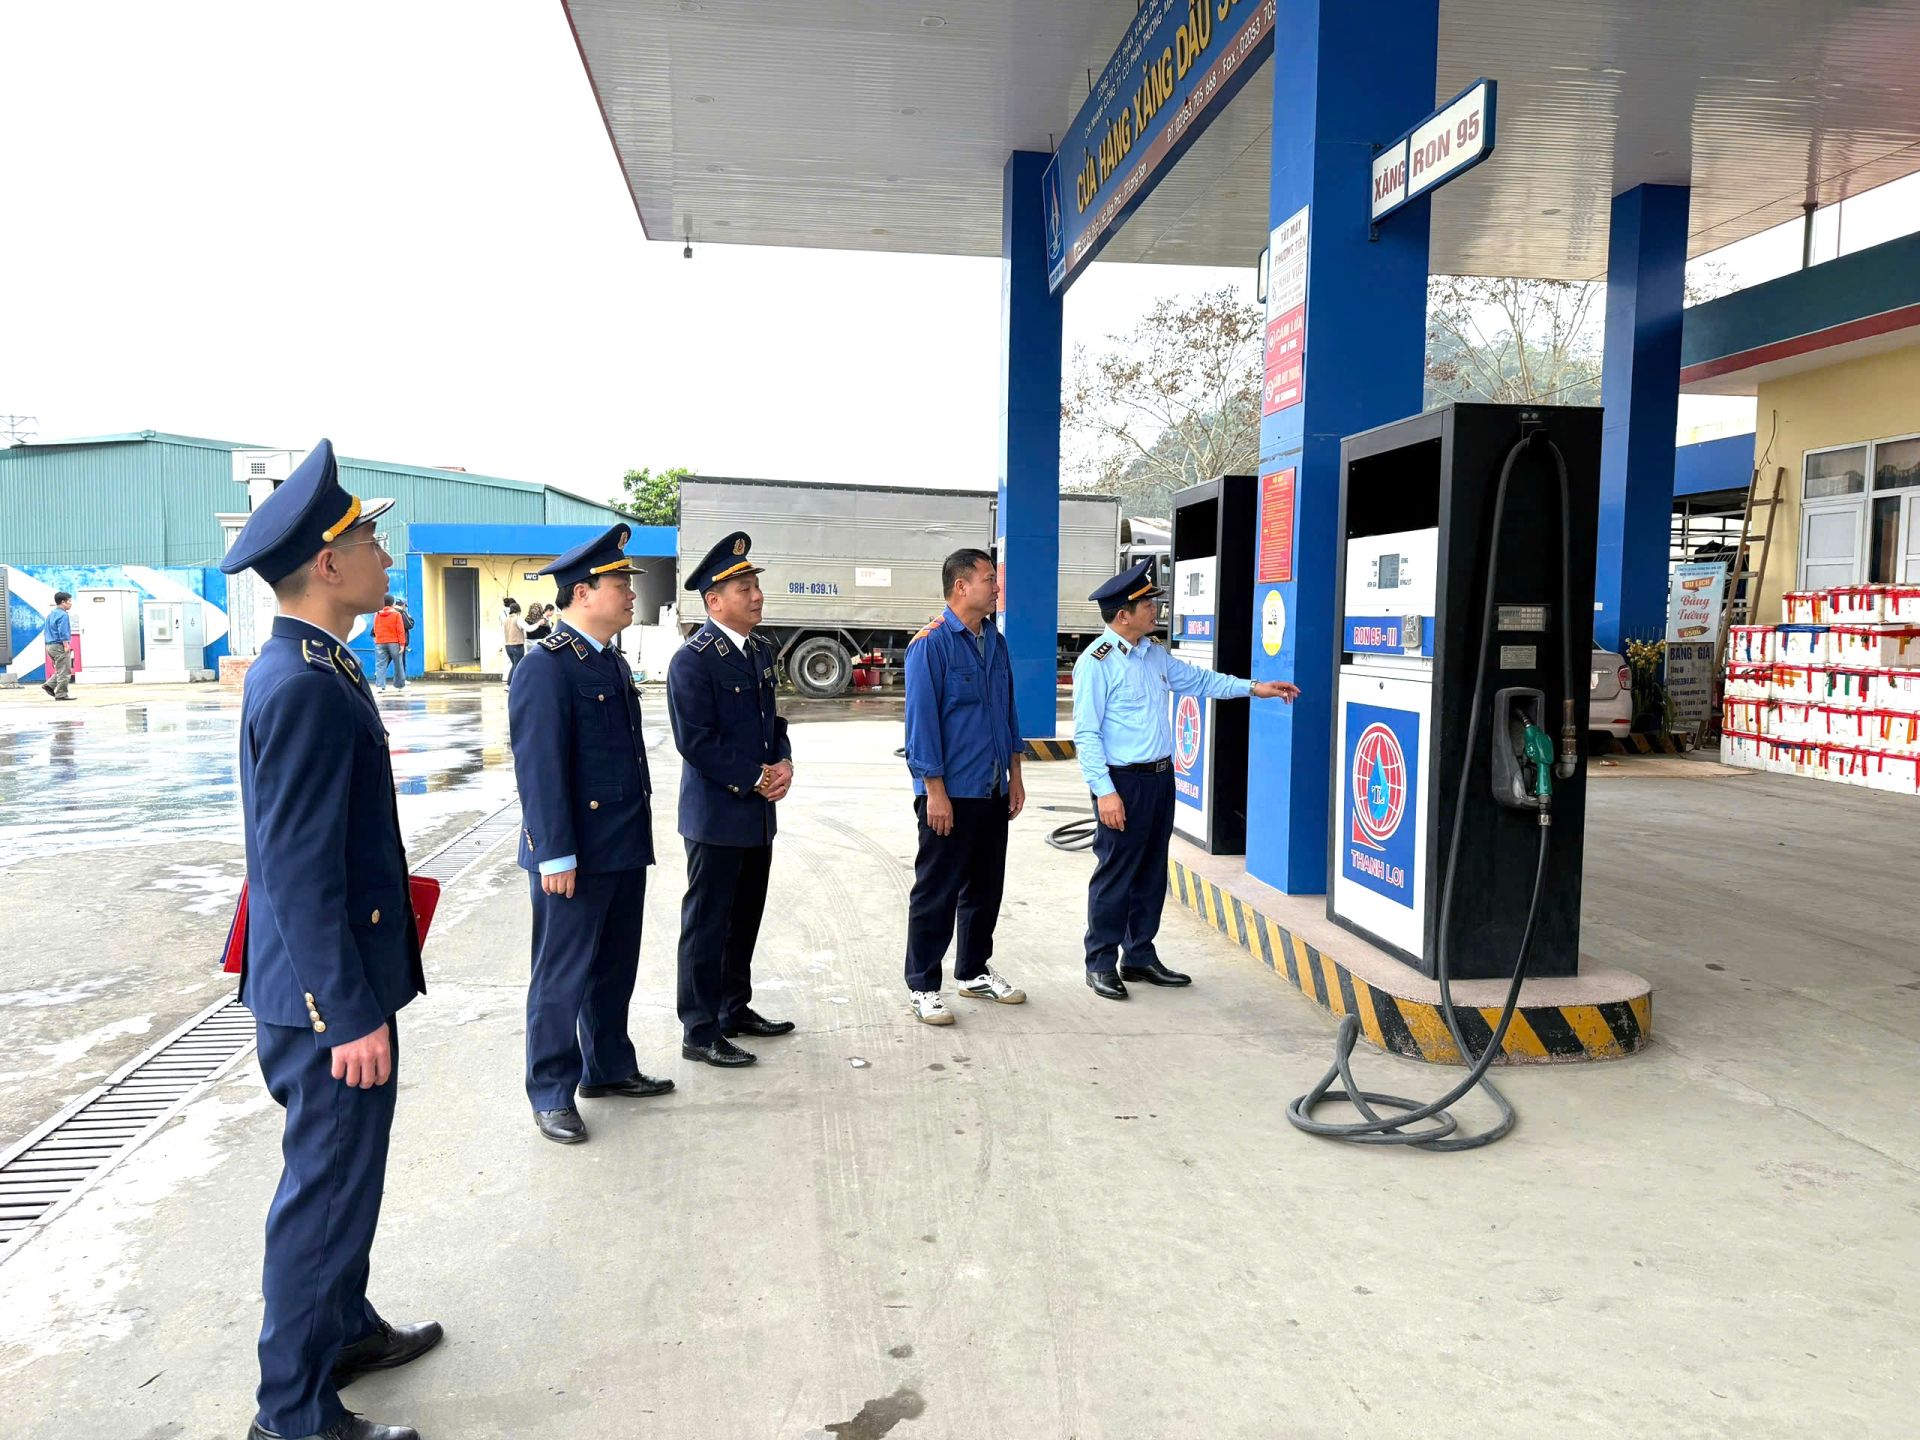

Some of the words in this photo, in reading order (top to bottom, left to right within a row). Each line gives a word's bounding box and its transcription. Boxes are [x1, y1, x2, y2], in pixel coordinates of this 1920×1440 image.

[1077, 146, 1098, 214] CỬA
[1098, 108, 1131, 185] HÀNG
[1133, 46, 1174, 141] XĂNG
[1374, 159, 1405, 203] XĂNG
[1412, 128, 1451, 178] RON
[1456, 109, 1480, 148] 95
[525, 573, 537, 581] WC
[1350, 848, 1385, 880] THANH
